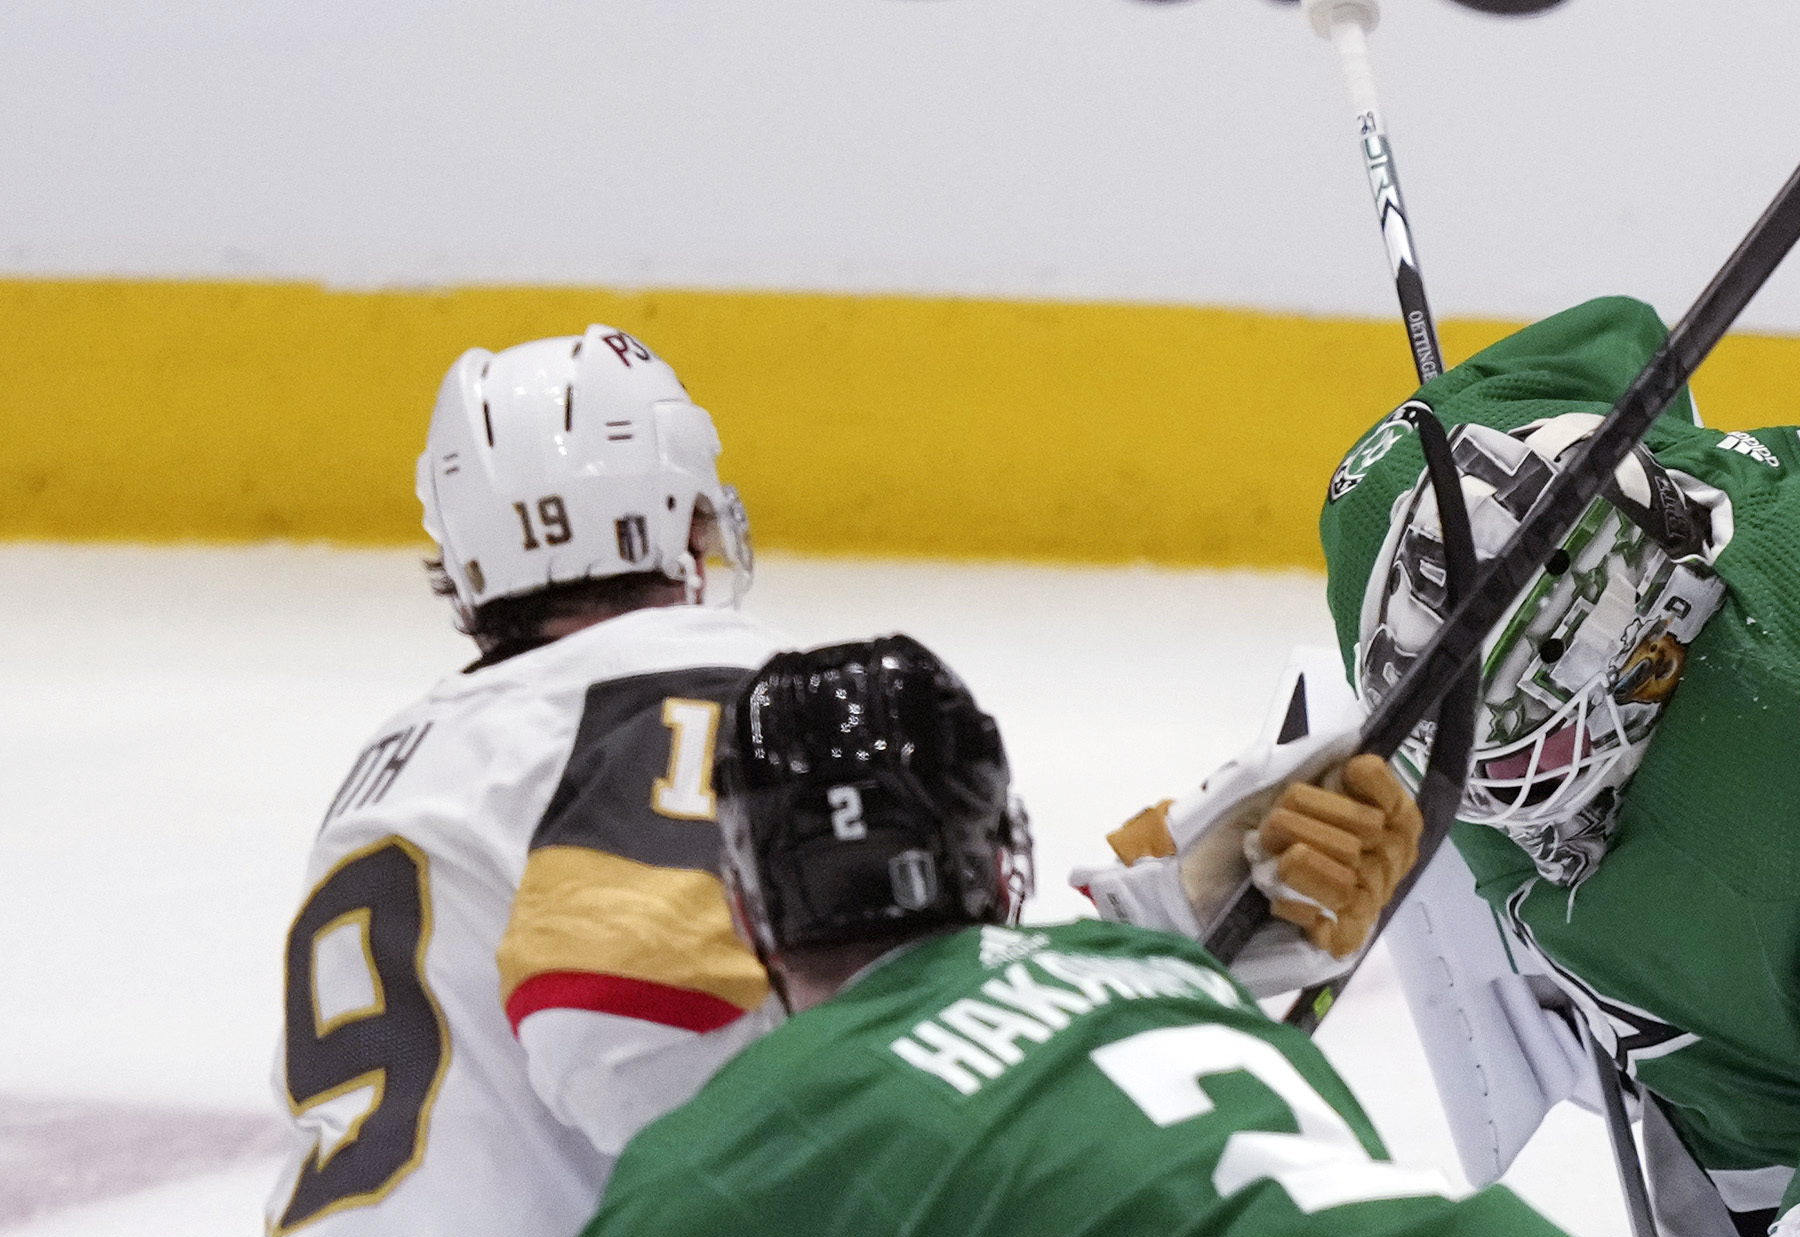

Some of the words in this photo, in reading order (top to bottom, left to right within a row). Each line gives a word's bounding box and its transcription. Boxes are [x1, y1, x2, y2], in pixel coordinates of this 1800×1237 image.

[512, 493, 574, 551] 19
[827, 786, 866, 842] 2
[1090, 1022, 1474, 1215] 2
